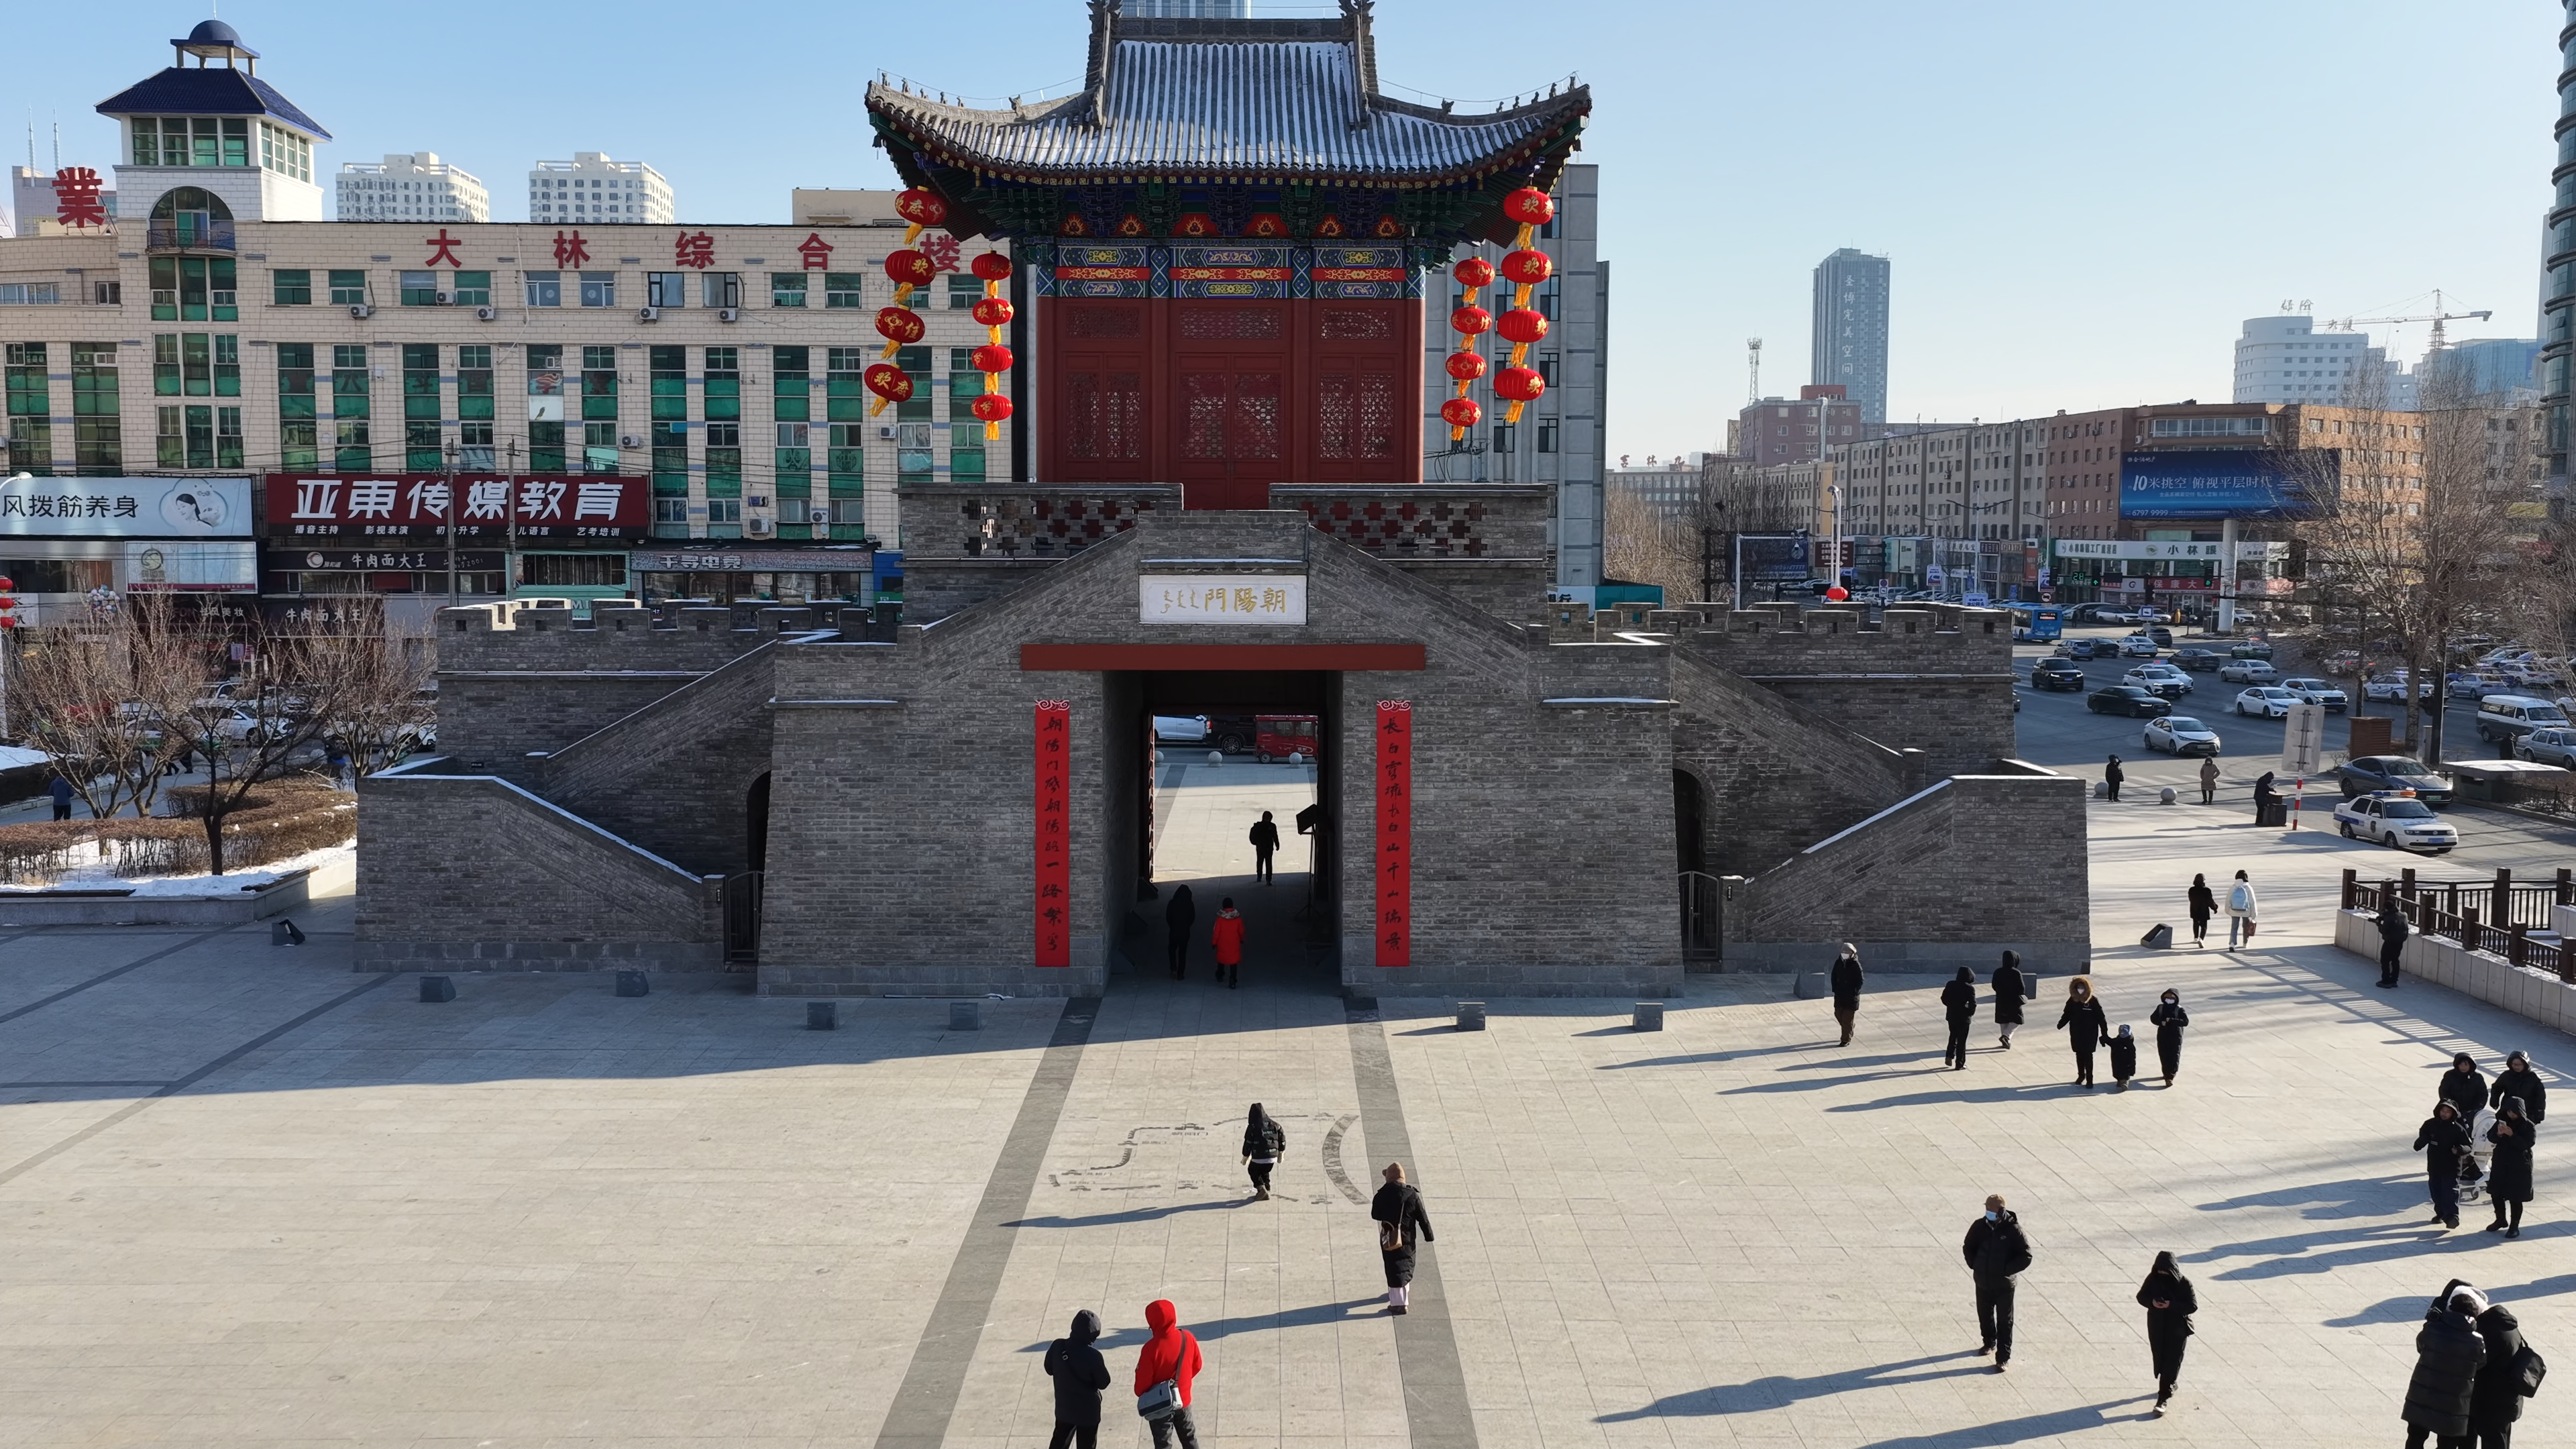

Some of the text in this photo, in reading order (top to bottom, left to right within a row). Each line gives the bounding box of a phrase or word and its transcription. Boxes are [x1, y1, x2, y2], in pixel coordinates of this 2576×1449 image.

[52, 166, 106, 228] 業
[425, 228, 962, 273] 大林综合楼
[1841, 274, 1856, 375] 圣博完美空间
[2192, 476, 2273, 489] 俯视平层时代
[2, 494, 139, 519] 风拨筋养身
[294, 525, 339, 535] 播音主持
[364, 525, 409, 535] 影视表演
[576, 527, 621, 537] 艺考培训
[351, 553, 427, 569] 牛肉面大王
[659, 554, 741, 569] 千寻电竞
[285, 607, 363, 623] 牛肉面大王
